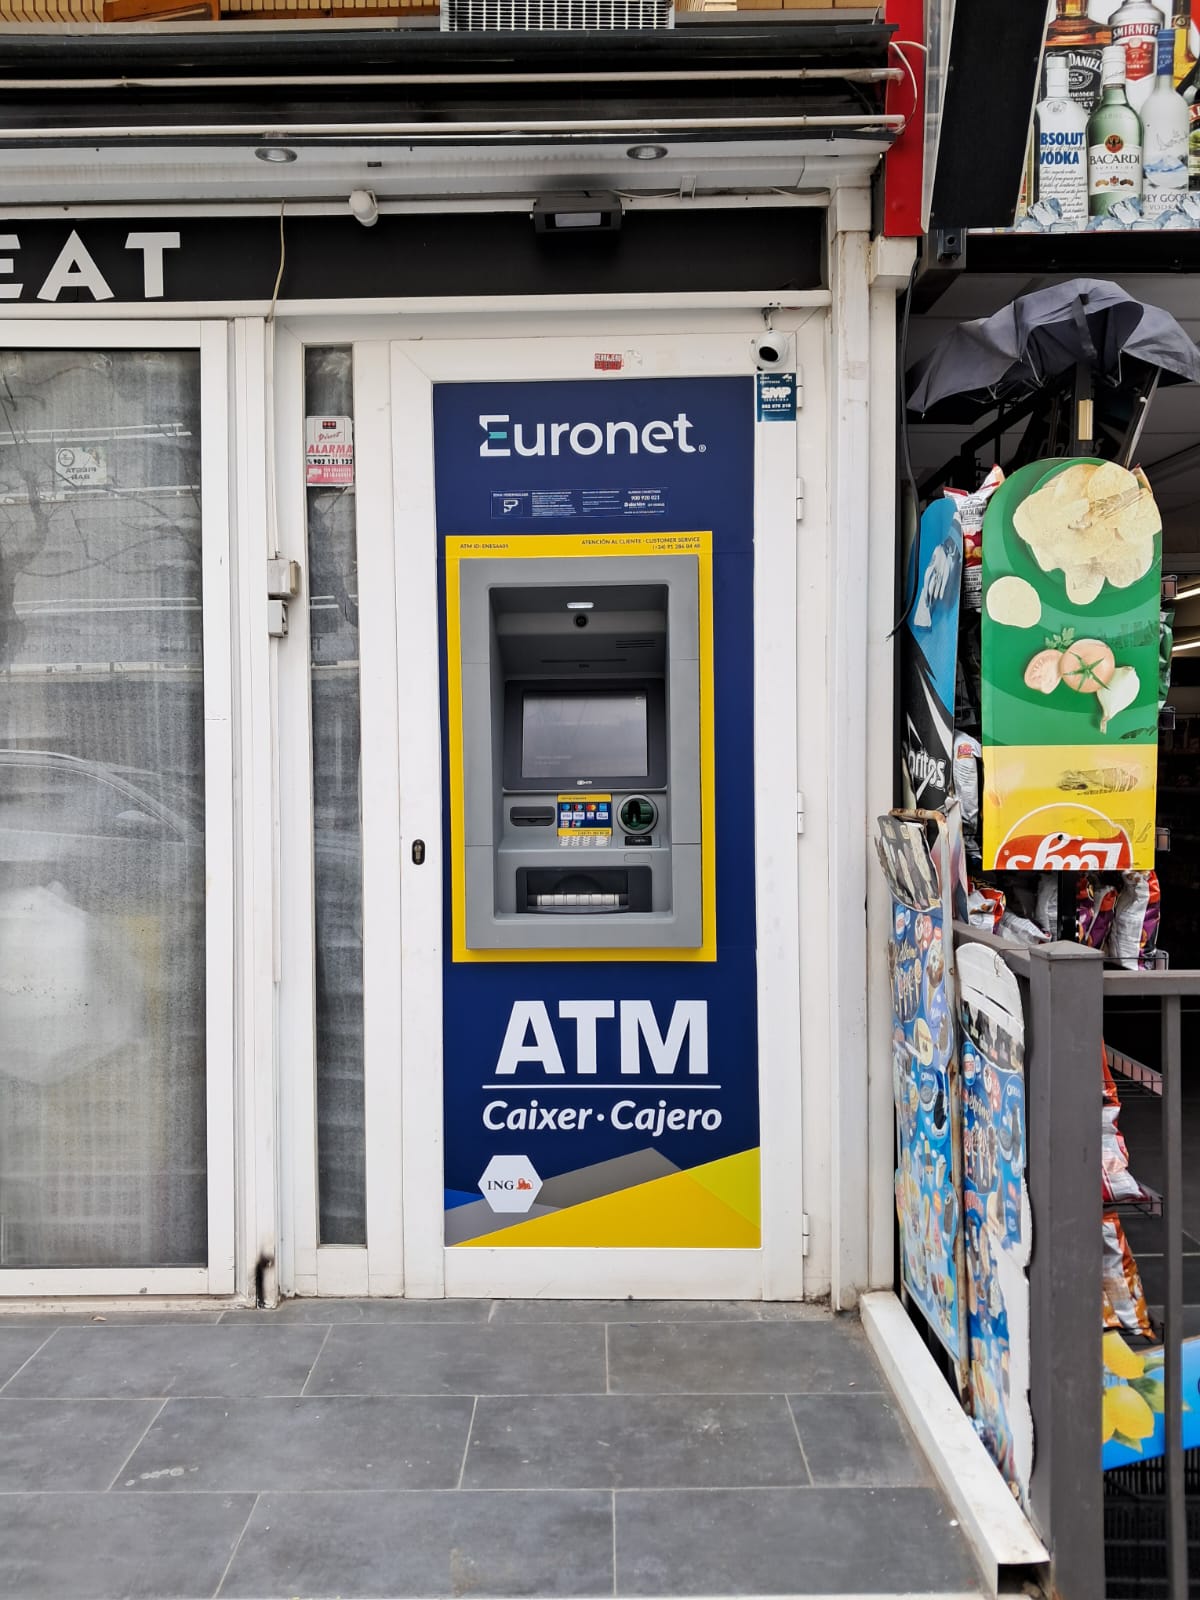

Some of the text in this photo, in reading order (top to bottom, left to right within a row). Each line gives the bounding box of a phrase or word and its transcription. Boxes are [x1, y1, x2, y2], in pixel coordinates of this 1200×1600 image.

[1113, 24, 1159, 39] SMIRNOFF
[1089, 154, 1140, 165] BACARDI
[479, 413, 697, 457] Euronet
[495, 1000, 709, 1075] ATM
[482, 1099, 723, 1137] Caixer Cajero
[487, 1180, 514, 1191] ING
